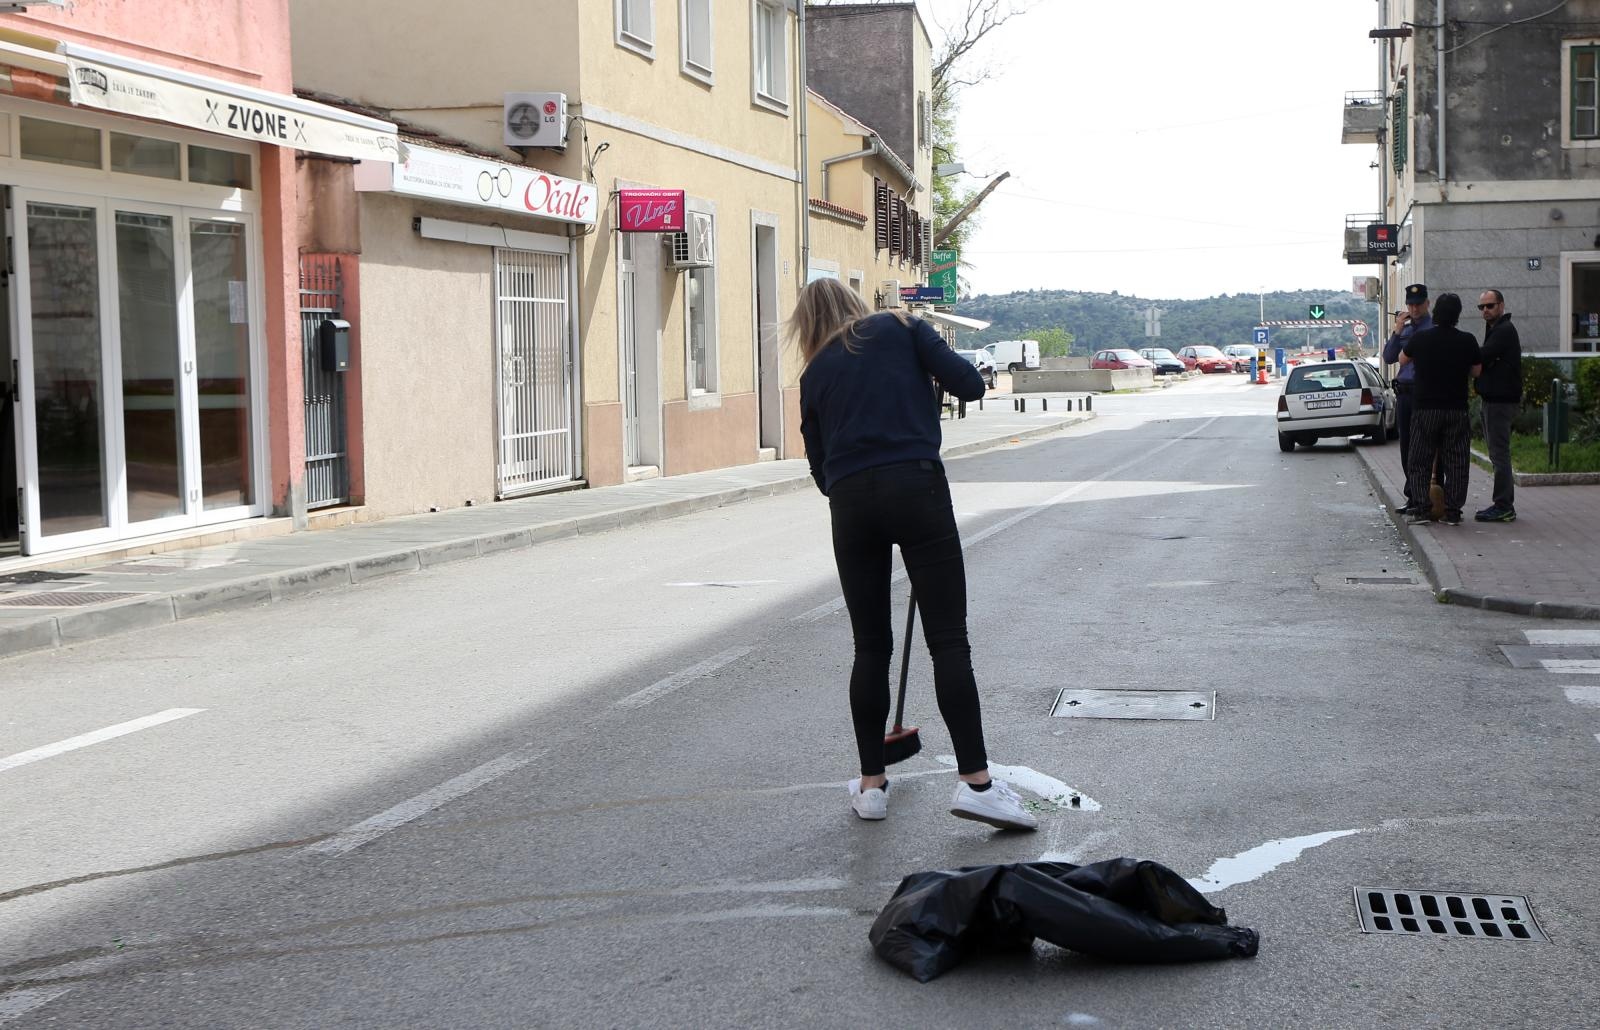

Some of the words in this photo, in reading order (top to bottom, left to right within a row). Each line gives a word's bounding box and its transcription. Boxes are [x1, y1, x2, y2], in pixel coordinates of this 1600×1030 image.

[227, 104, 287, 139] ZVONE
[524, 175, 589, 219] Očale
[626, 199, 676, 227] Una
[1368, 241, 1396, 249] Stretto
[933, 252, 951, 261] Buffet
[1299, 391, 1348, 400] POLICIJA
